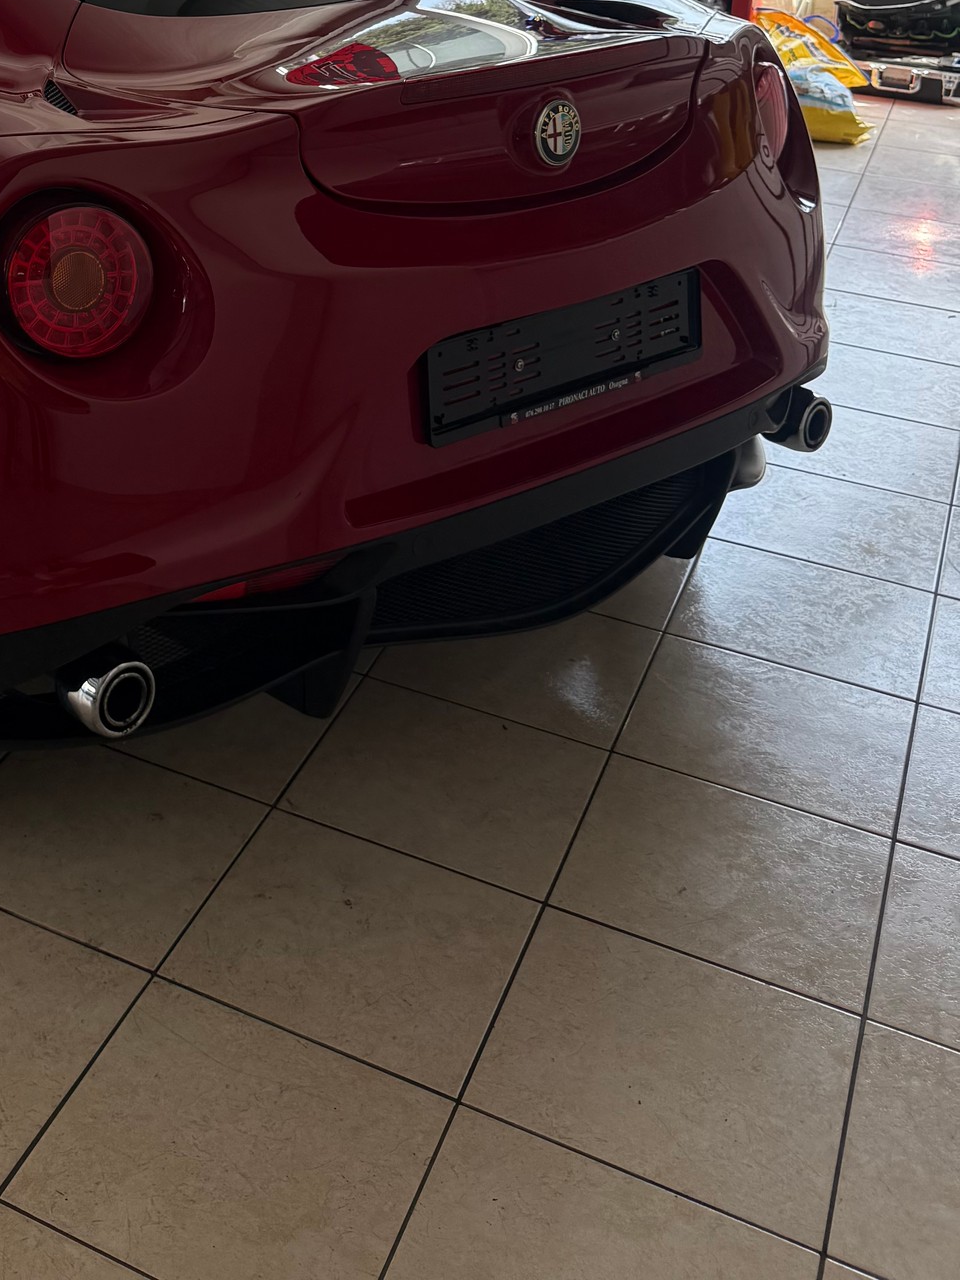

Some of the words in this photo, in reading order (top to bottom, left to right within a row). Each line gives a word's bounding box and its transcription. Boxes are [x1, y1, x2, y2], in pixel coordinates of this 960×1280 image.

[541, 111, 555, 138] ALFA
[558, 105, 580, 131] ROMEO
[558, 389, 588, 407] PIRONACI
[588, 384, 606, 397] AUTO
